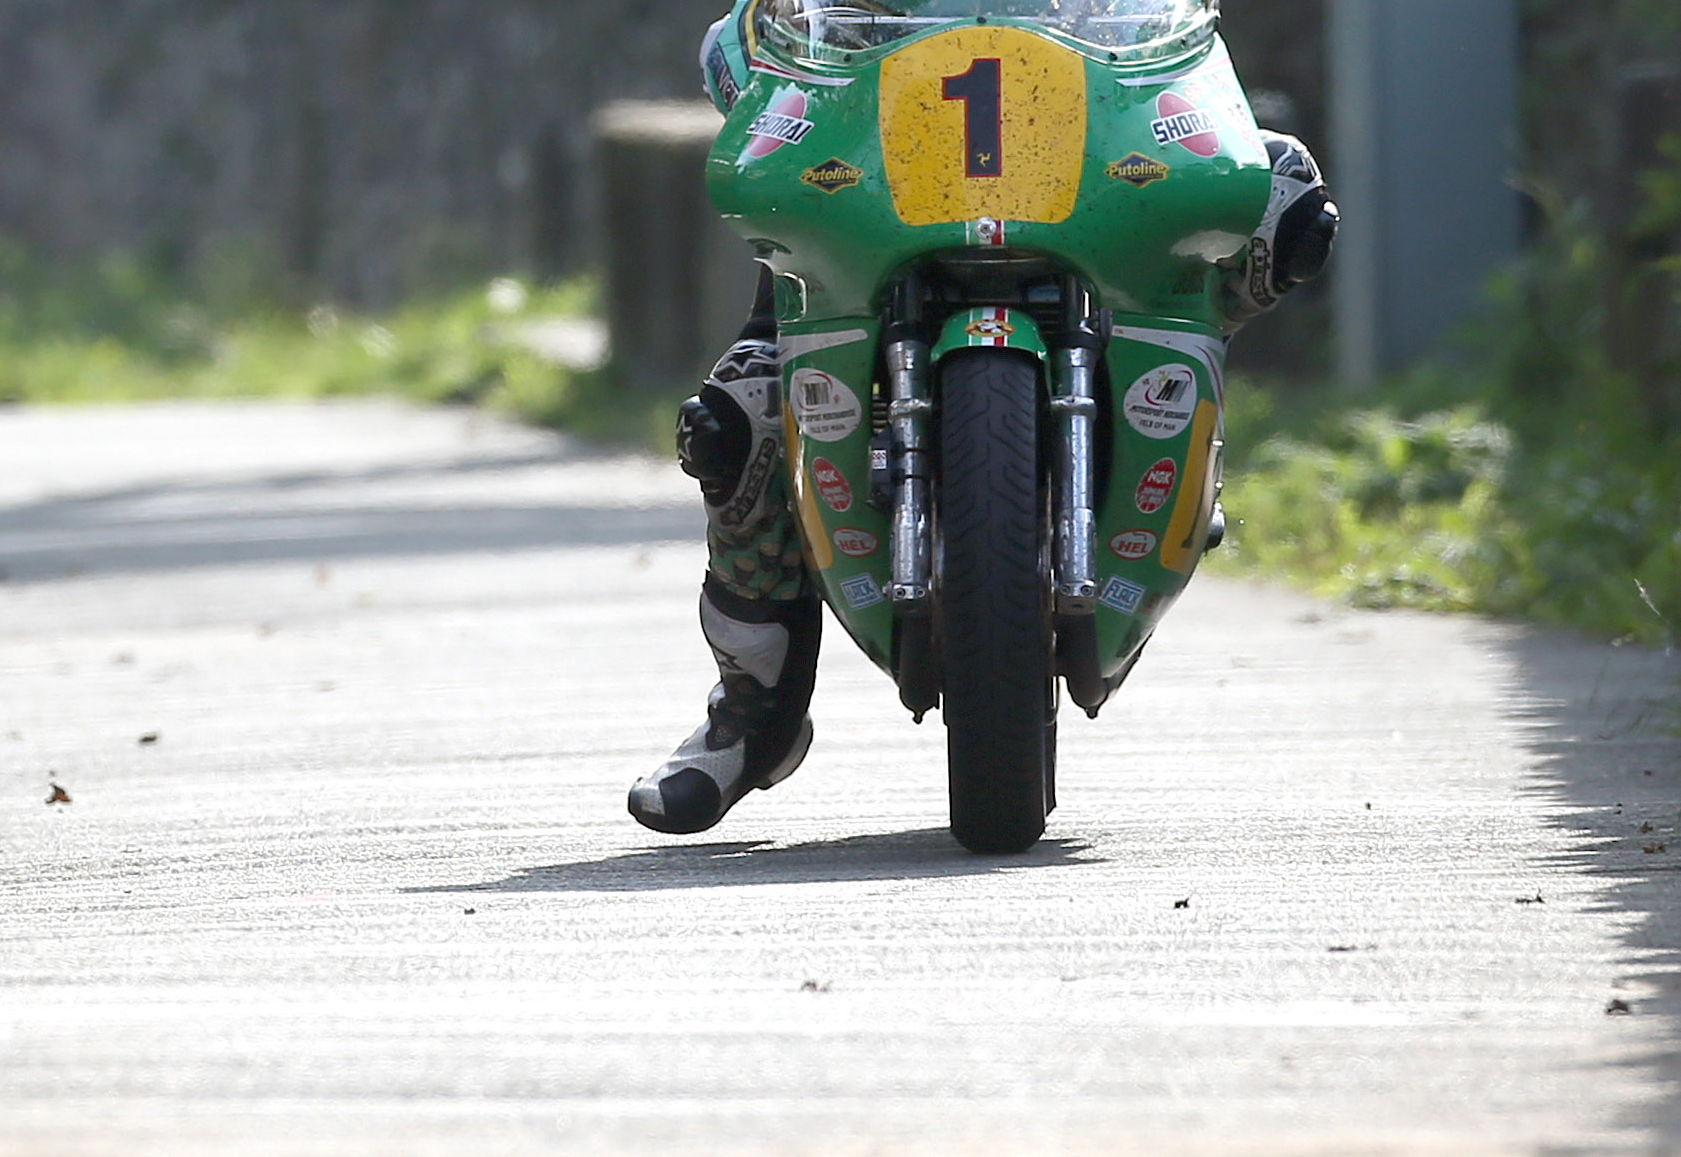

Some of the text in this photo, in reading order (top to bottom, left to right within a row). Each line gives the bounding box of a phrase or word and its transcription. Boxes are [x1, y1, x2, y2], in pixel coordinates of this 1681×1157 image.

[941, 57, 1002, 178] 1
[748, 113, 813, 142] SHORAI
[803, 166, 859, 181] Putoline
[1109, 162, 1165, 177] Putoline
[815, 470, 840, 483] NGK
[1147, 470, 1172, 485] NGK
[839, 540, 871, 551] HEL
[1117, 541, 1150, 554] HEL
